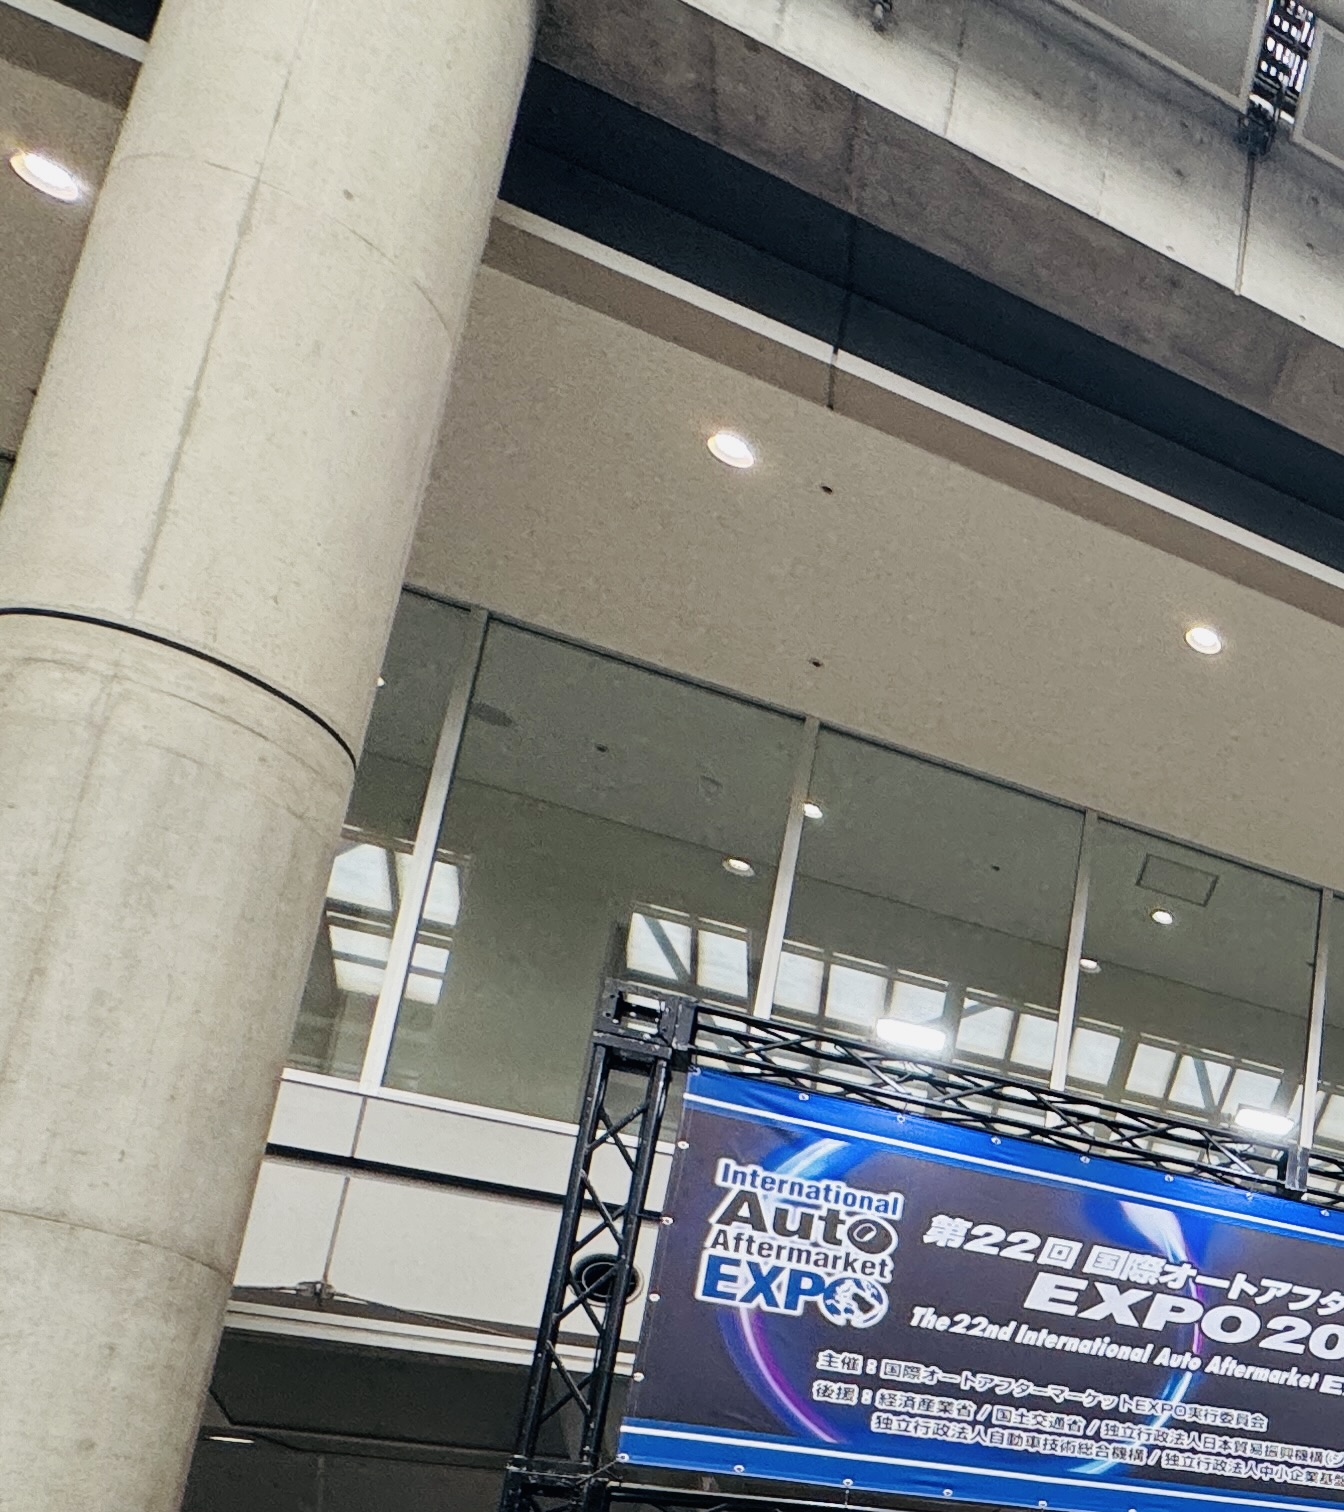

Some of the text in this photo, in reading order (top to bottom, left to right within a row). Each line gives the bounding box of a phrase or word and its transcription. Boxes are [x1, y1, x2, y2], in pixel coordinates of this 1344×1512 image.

[721, 1163, 899, 1216] International
[716, 1189, 894, 1254] Auto
[923, 1214, 1083, 1270] 第22回
[711, 1229, 889, 1279] Aftermarket
[702, 1254, 886, 1327] EXPO
[909, 1306, 951, 1332] The
[1015, 1323, 1155, 1364] International
[1153, 1347, 1202, 1371] Auto
[1204, 1355, 1320, 1390] Aftermarket
